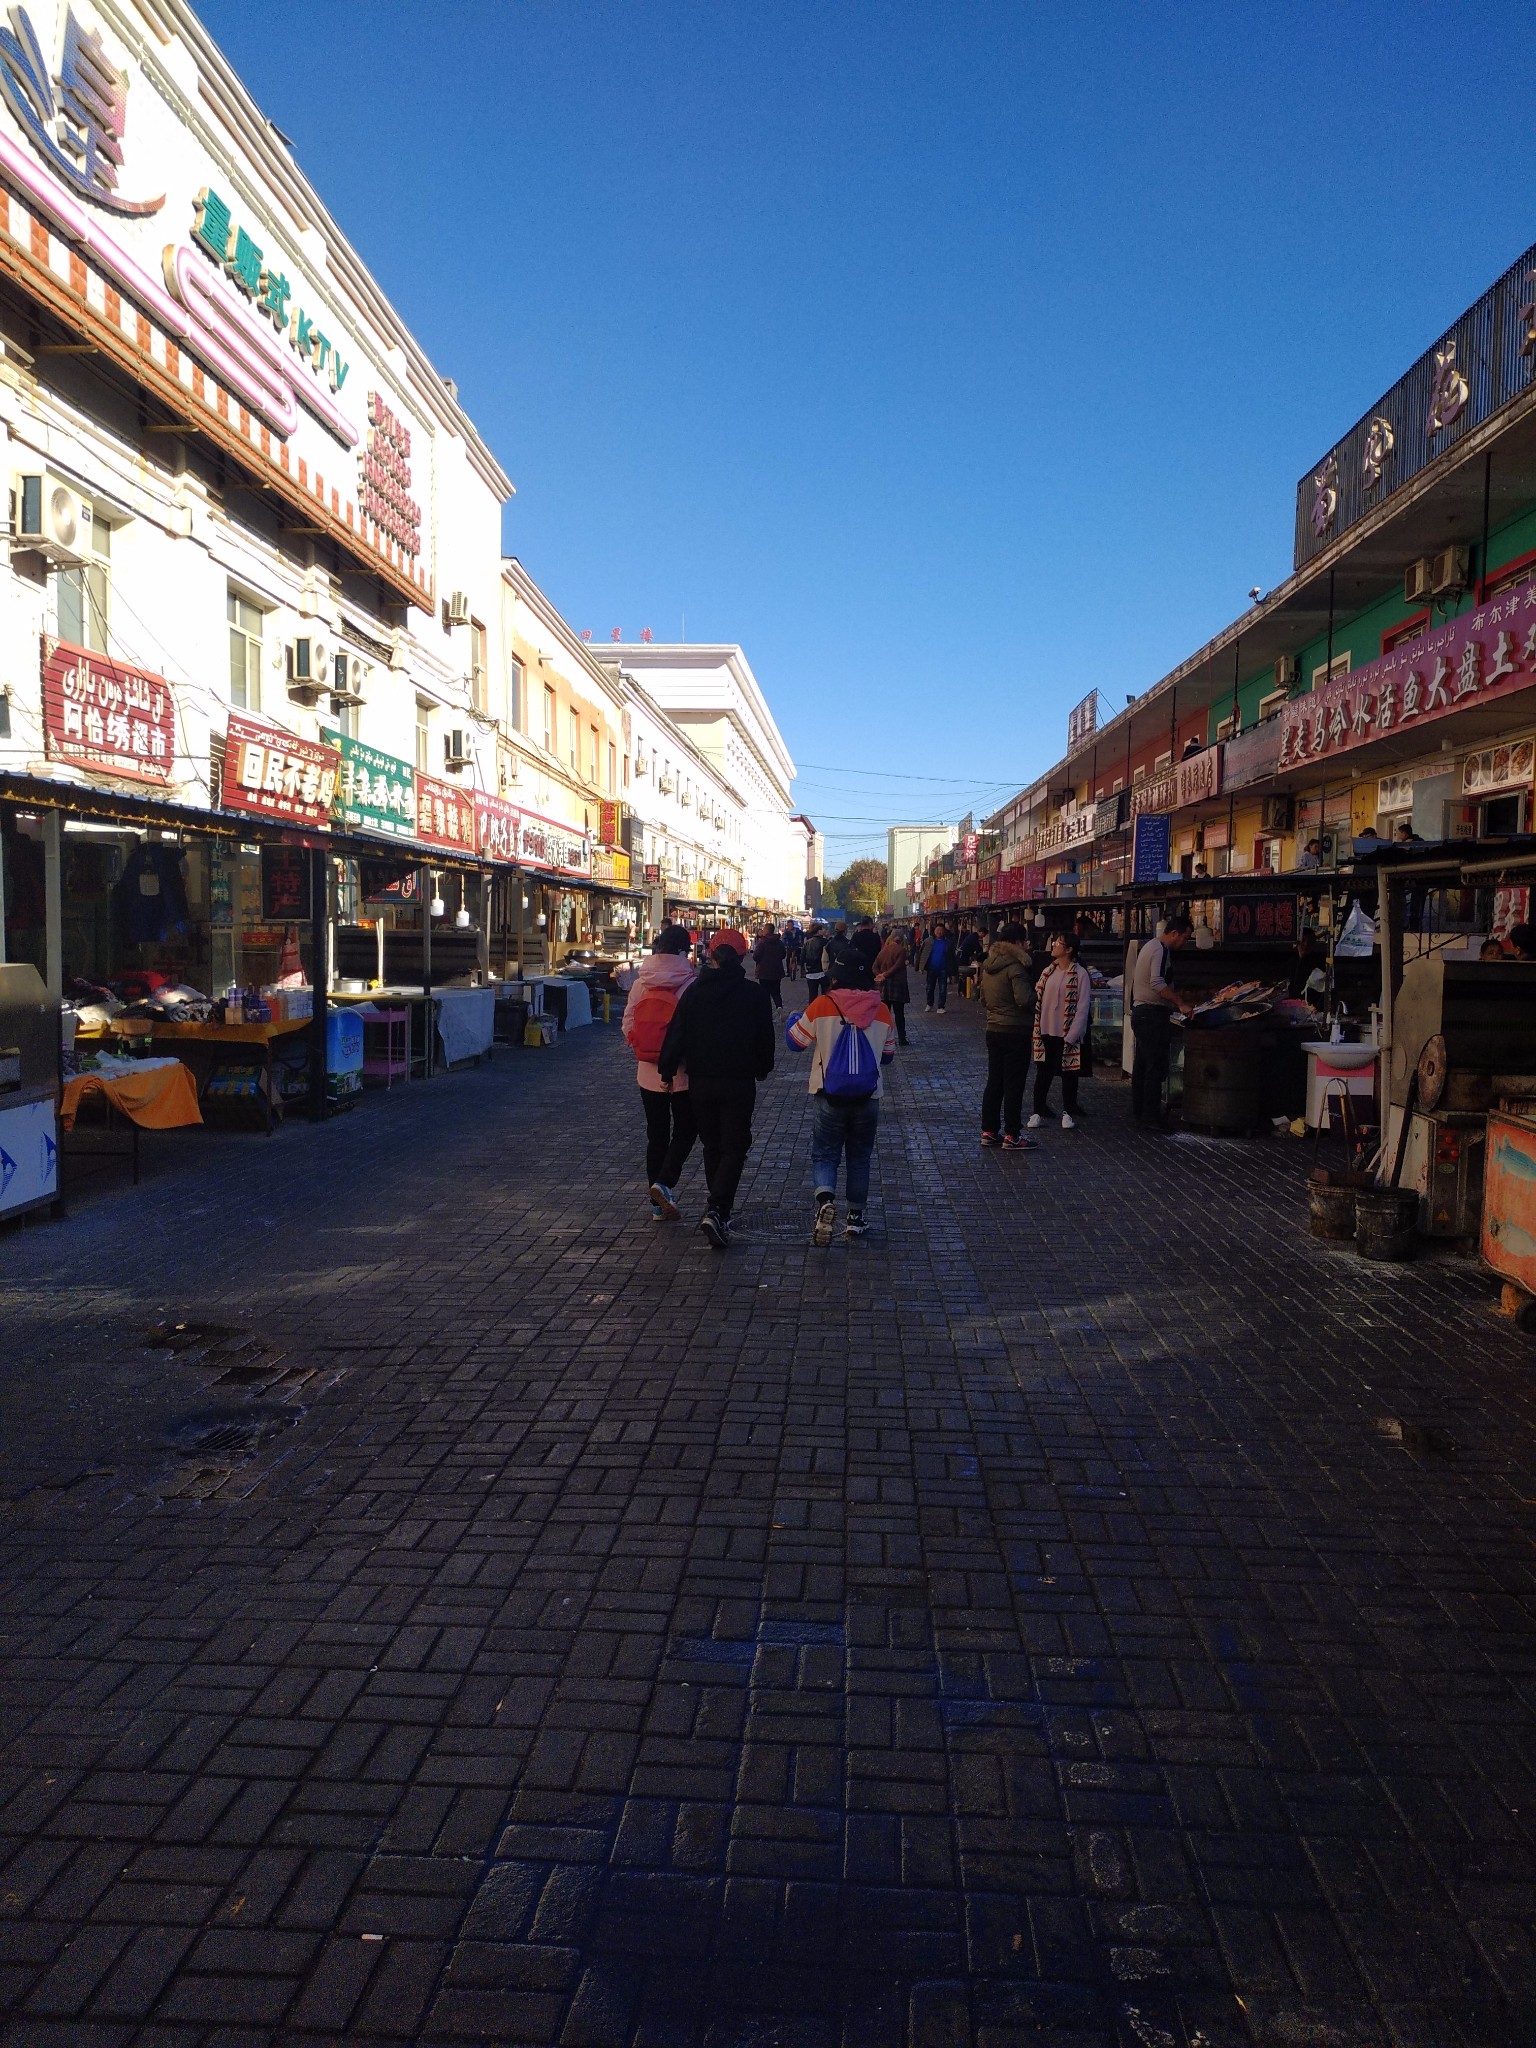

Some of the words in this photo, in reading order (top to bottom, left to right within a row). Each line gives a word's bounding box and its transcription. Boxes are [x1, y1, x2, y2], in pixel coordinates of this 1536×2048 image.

[63, 699, 167, 761] 阿恰绣超市
[966, 835, 977, 863] 足浴
[271, 850, 301, 916] 土特产
[1229, 904, 1251, 935] 20
[1256, 900, 1294, 937] 烧烤
